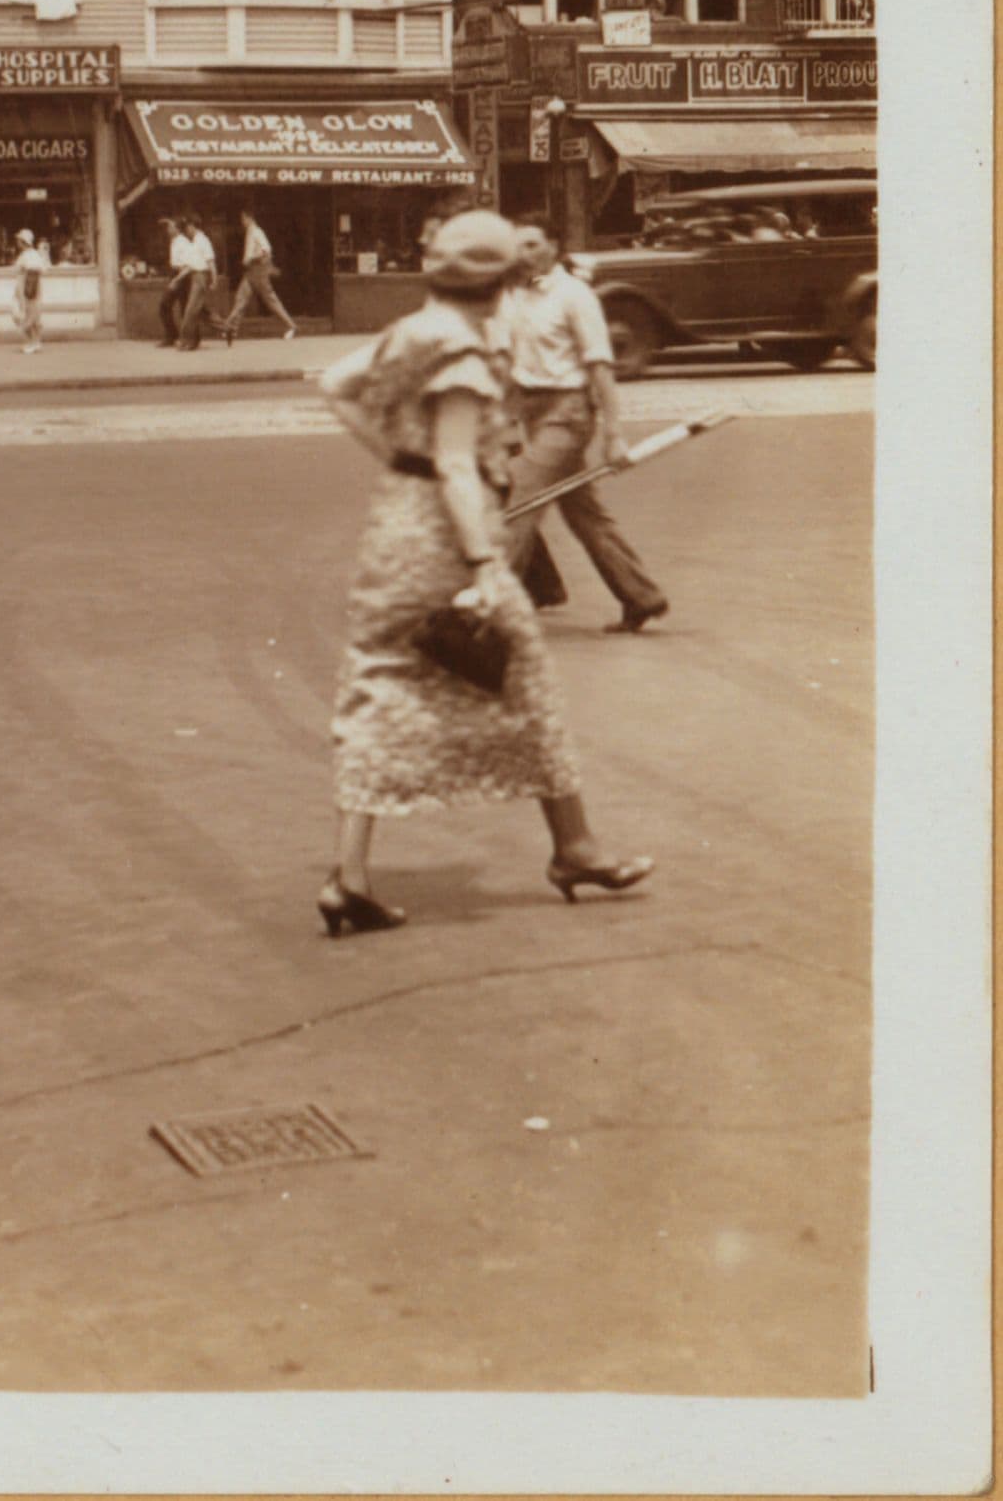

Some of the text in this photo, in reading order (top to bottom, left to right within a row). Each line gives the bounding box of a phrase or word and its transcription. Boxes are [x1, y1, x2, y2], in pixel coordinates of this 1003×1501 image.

[1, 68, 111, 87] SUPPLIES
[588, 61, 677, 90] FRUIT
[726, 60, 798, 89] BLATT
[170, 114, 413, 132] GOLDEN GLOW
[22, 139, 87, 158] CIGARS
[170, 140, 295, 153] RESTAURANT
[203, 168, 268, 181] GOLDEN
[277, 169, 323, 181] GLOW
[332, 170, 433, 183] RESTAURANT
